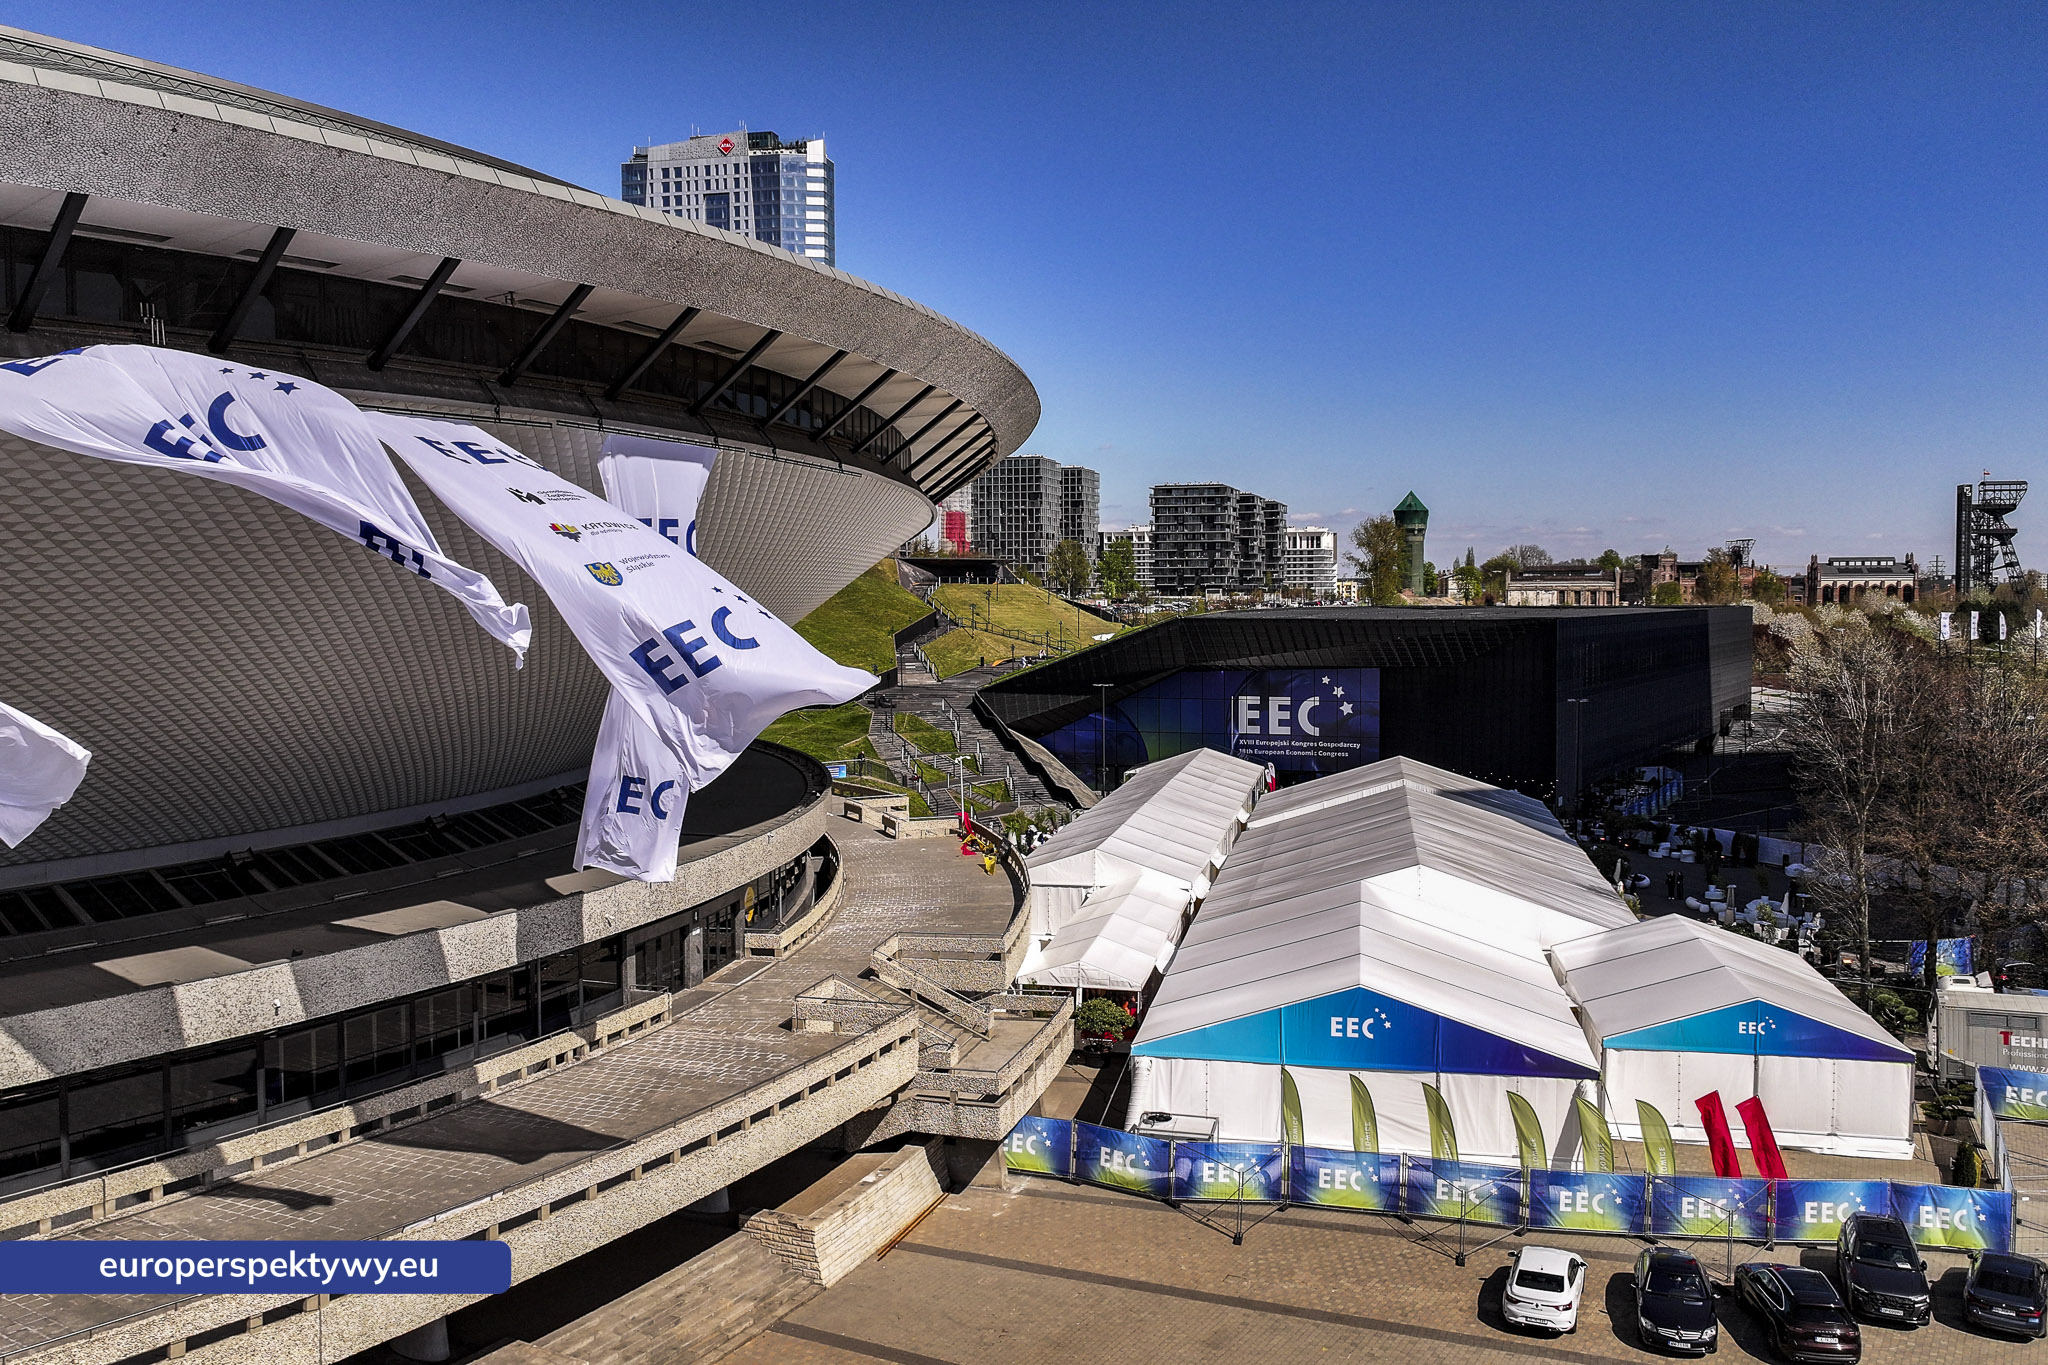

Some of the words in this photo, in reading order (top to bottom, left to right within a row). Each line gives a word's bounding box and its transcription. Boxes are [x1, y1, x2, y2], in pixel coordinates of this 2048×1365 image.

[581, 521, 639, 531] KATOWICE
[629, 606, 760, 695] EEC
[1238, 695, 1320, 736] EEC
[1318, 741, 1361, 750] Gospodarczy
[1318, 750, 1349, 758] Congress
[1330, 1016, 1374, 1039] EEC
[1738, 1021, 1765, 1035] EEC
[2005, 1085, 2048, 1107] EEC
[1100, 1146, 1136, 1175] EEC
[1202, 1162, 1245, 1184] EEC
[1318, 1167, 1362, 1192] EEC
[1436, 1178, 1481, 1204] EEC
[1559, 1190, 1604, 1215] EEC
[1681, 1196, 1728, 1219] EEC
[1804, 1201, 1849, 1224] EEC
[1919, 1205, 1967, 1232] EEC
